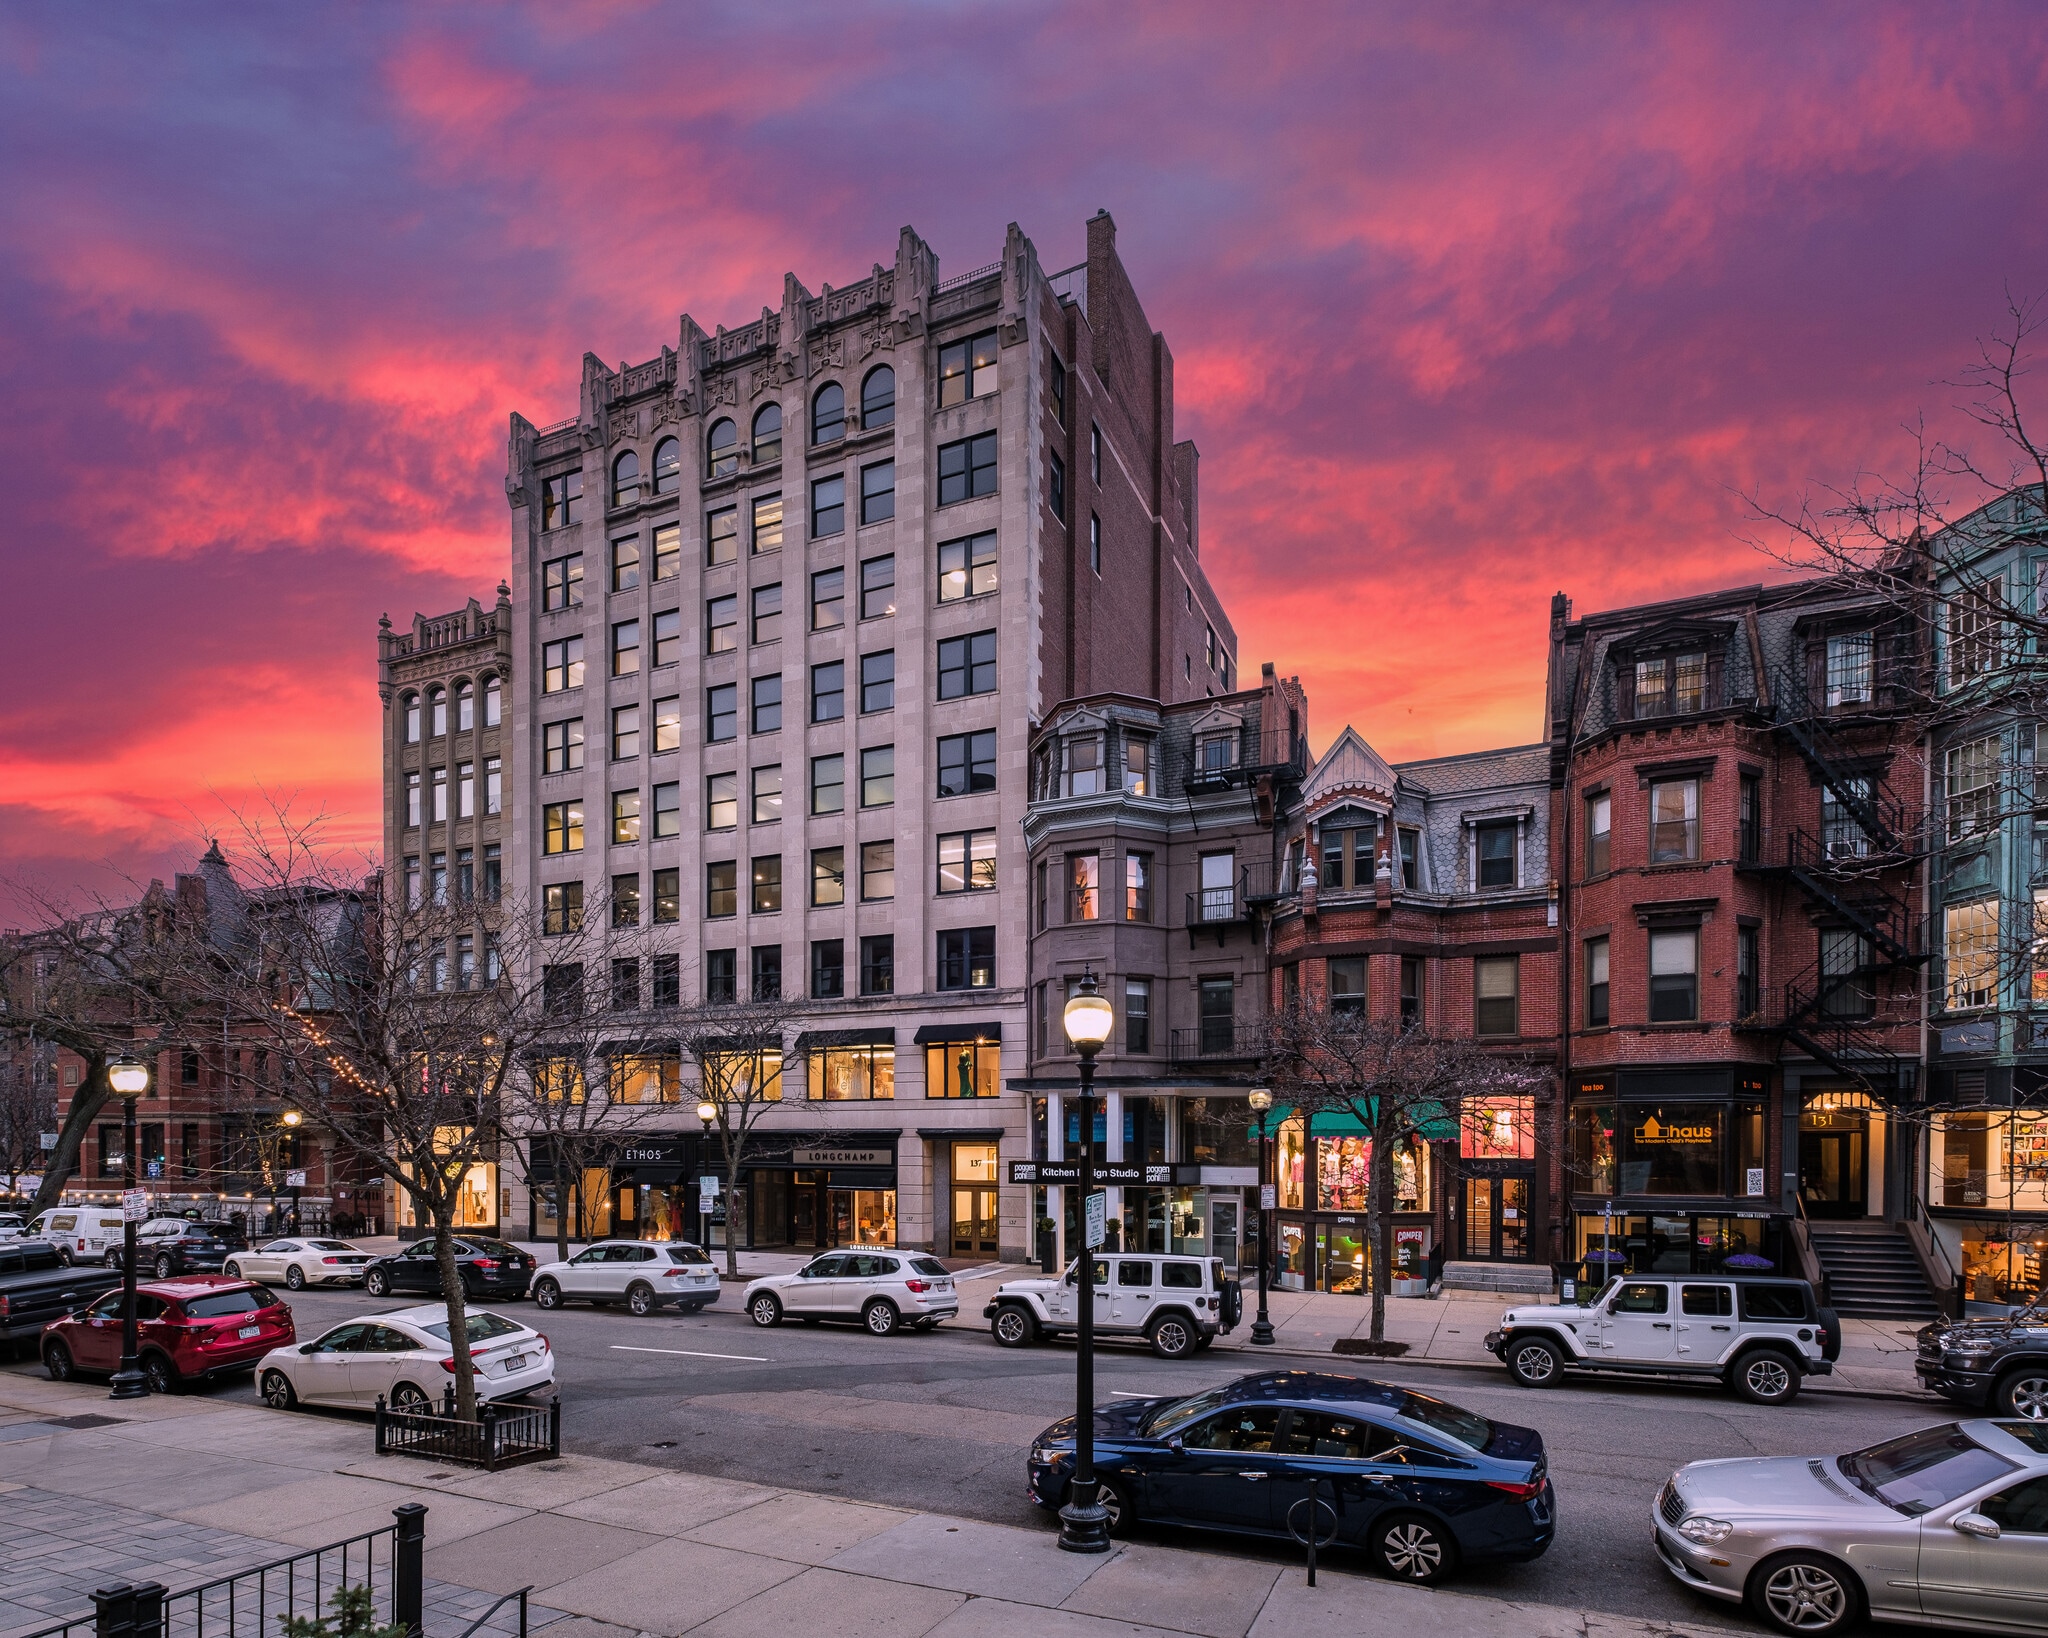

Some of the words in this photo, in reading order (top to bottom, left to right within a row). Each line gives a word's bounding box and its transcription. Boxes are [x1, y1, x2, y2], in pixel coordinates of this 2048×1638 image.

[1812, 1114, 1832, 1127] 131
[1669, 1125, 1712, 1138] haus
[626, 1149, 661, 1160] ETHOS
[808, 1152, 875, 1161] LONGCHAMP
[970, 1159, 982, 1168] 137
[1014, 1164, 1036, 1173] poggen
[1042, 1167, 1075, 1177] Kitchen
[1109, 1168, 1140, 1178] Studio
[1146, 1166, 1170, 1175] poggen
[1283, 1226, 1302, 1240] CAMPER
[1397, 1230, 1423, 1242] CAMPER
